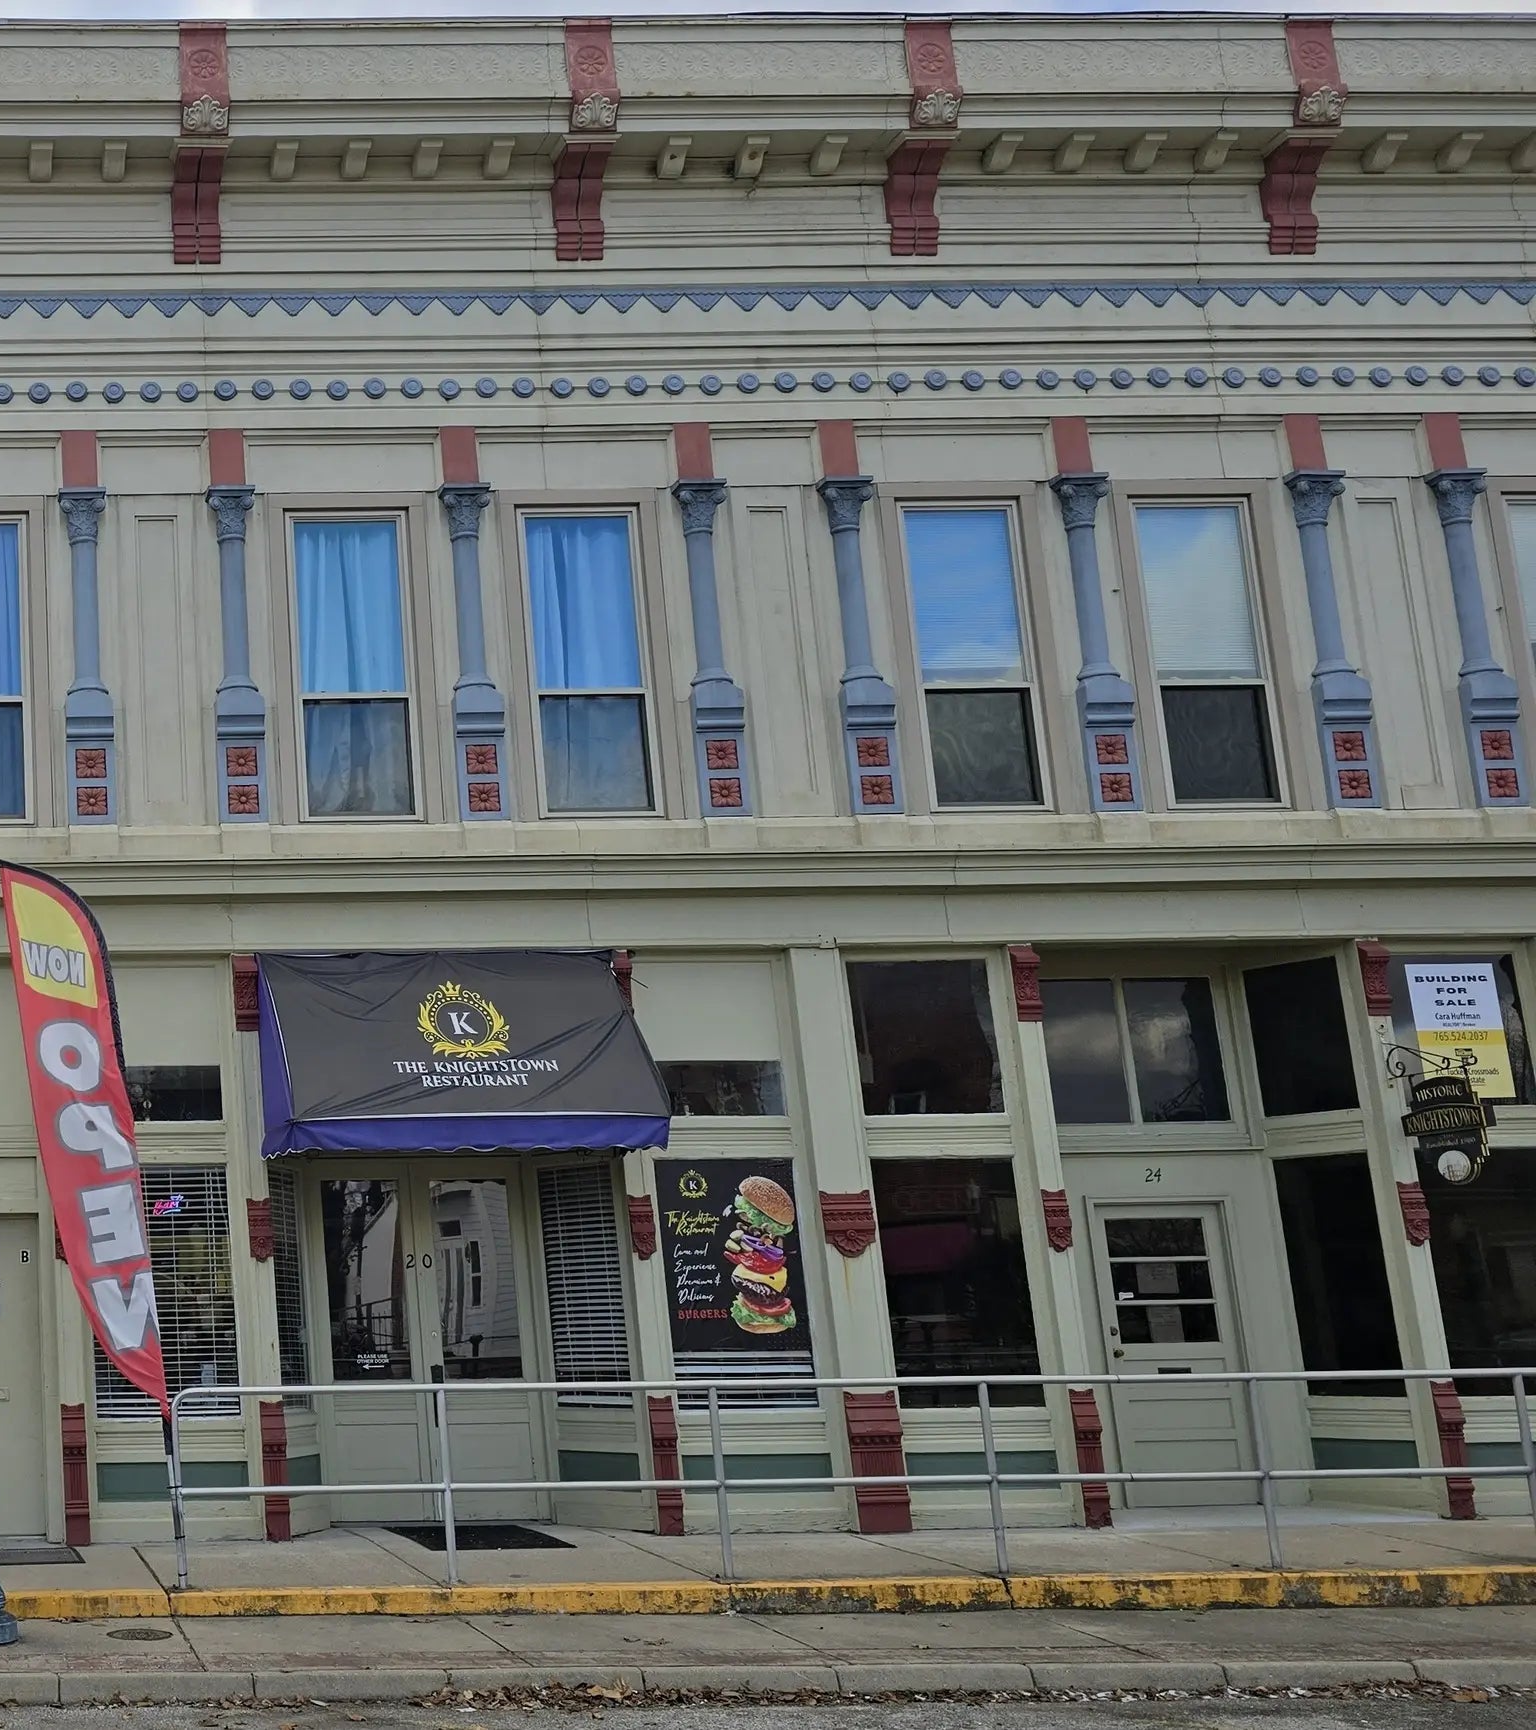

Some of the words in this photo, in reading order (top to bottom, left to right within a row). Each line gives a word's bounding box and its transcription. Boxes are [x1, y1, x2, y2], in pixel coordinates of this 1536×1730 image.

[1414, 975, 1488, 983] BUILDING
[1435, 1012, 1450, 1020] Cara
[1451, 1012, 1481, 1020] Huffman
[448, 1012, 478, 1035] K
[1433, 1031, 1488, 1041] 765.524.2037
[393, 1061, 428, 1074] THE
[433, 1059, 559, 1074] KNIGHTSTOWN
[1467, 1067, 1500, 1076] Crossroads
[421, 1074, 528, 1087] RESTAURANT
[1416, 1083, 1463, 1102] HISTORIC
[1406, 1107, 1481, 1134] KNIGHTSTOWN
[1145, 1168, 1162, 1183] 24
[689, 1180, 697, 1190] K
[675, 1222, 720, 1236] Restaurant
[21, 1250, 30, 1263] B
[674, 1243, 692, 1258] Come
[694, 1242, 709, 1256] and
[674, 1259, 717, 1277] Experience
[676, 1274, 713, 1288] Premium
[678, 1288, 715, 1304] Delicious
[678, 1309, 728, 1319] BURGERS
